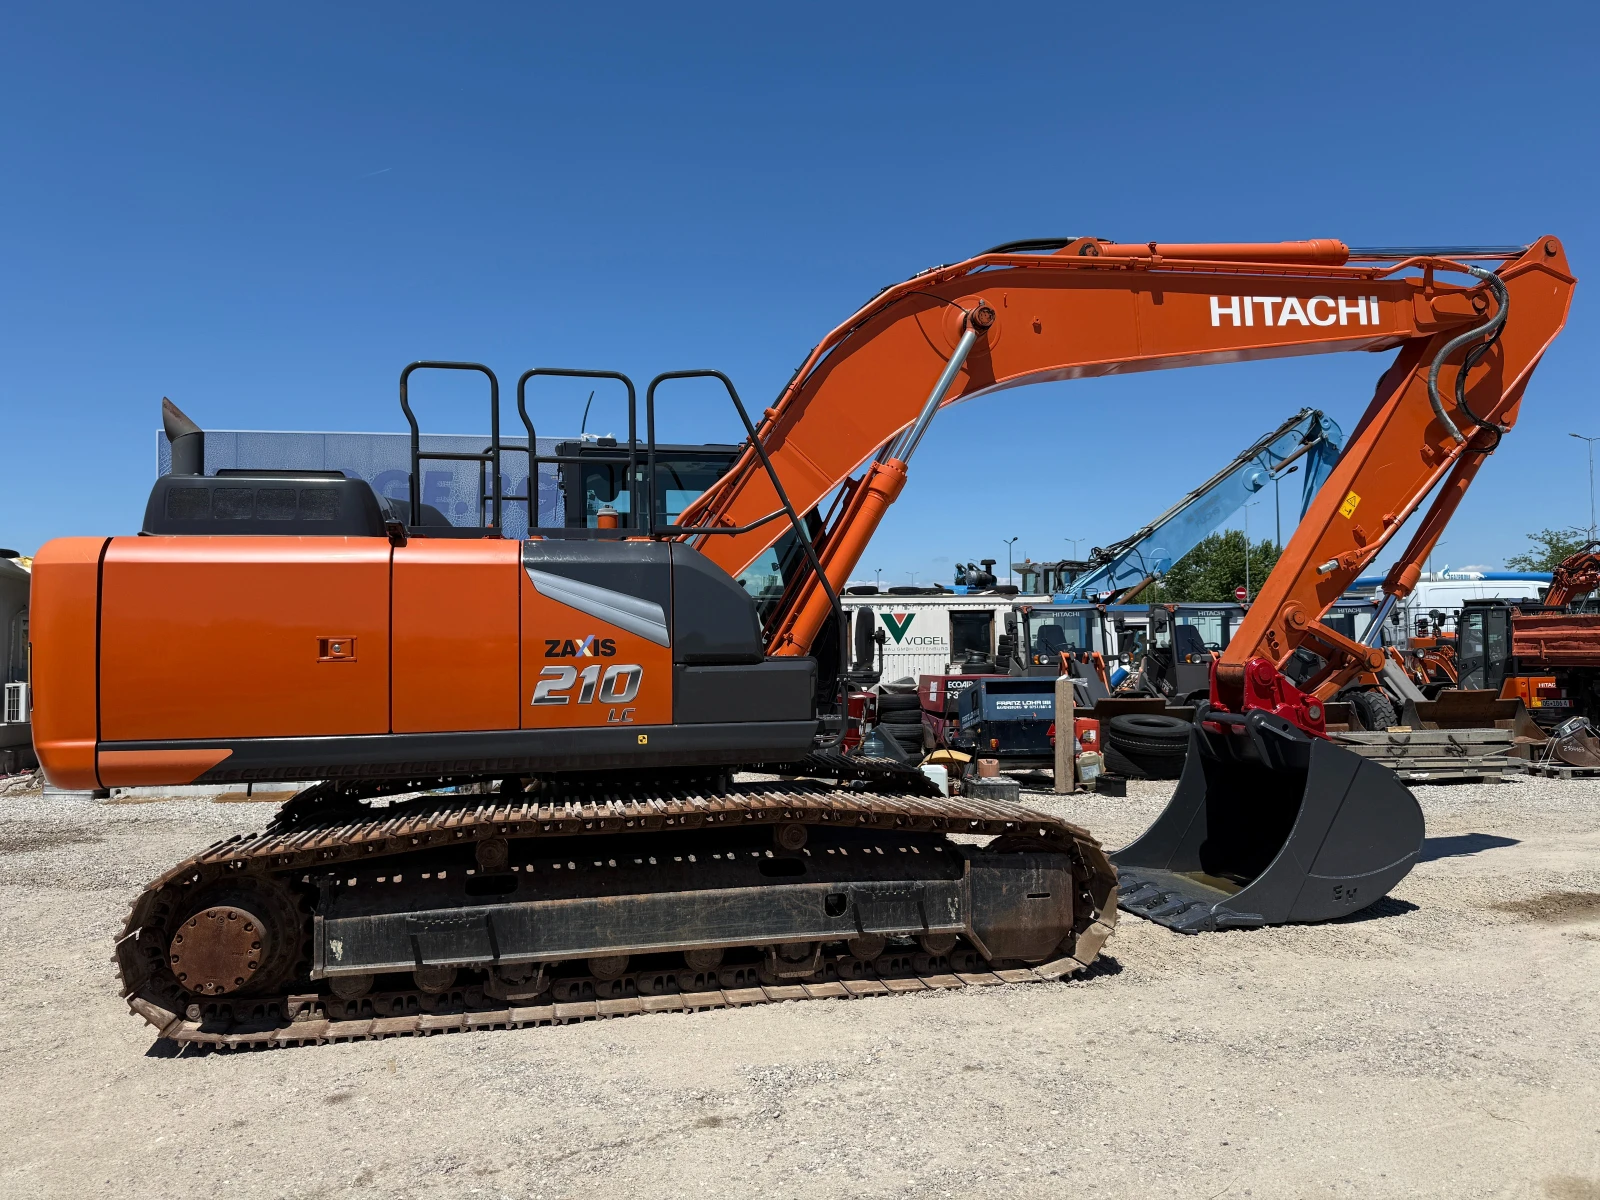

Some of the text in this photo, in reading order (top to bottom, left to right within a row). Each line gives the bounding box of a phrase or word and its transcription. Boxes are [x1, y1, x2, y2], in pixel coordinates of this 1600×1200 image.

[1209, 295, 1380, 327] HITACHI
[544, 634, 617, 658] ZAXIS
[905, 636, 948, 646] VOGEL
[530, 664, 644, 706] 210
[606, 707, 636, 723] LC
